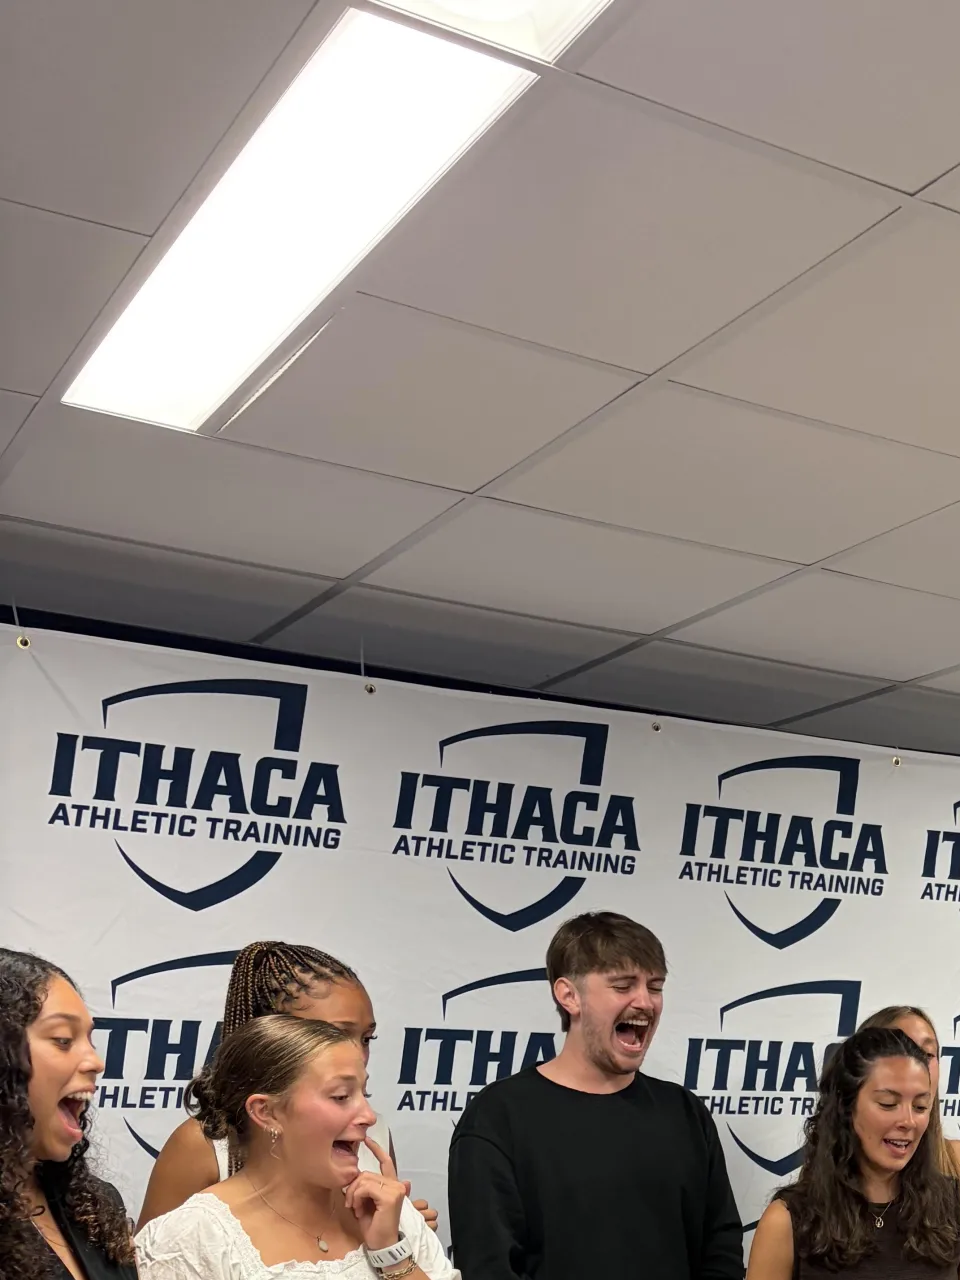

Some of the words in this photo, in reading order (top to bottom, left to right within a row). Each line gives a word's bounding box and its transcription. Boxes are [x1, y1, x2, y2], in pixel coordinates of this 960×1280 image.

[48, 732, 347, 824] ITHACA
[48, 803, 196, 837] ATHLETIC
[206, 817, 341, 849] TRAINING
[393, 771, 641, 851] ITHACA
[392, 835, 515, 864] ATHLETIC
[522, 846, 636, 875] TRAINING
[679, 803, 888, 874] ITHACA
[679, 861, 781, 888] ATHLETIC
[788, 870, 884, 896] TRAINING
[396, 1027, 557, 1086] ITHA
[684, 1038, 842, 1092] ITHA
[95, 1085, 199, 1109] HLETI
